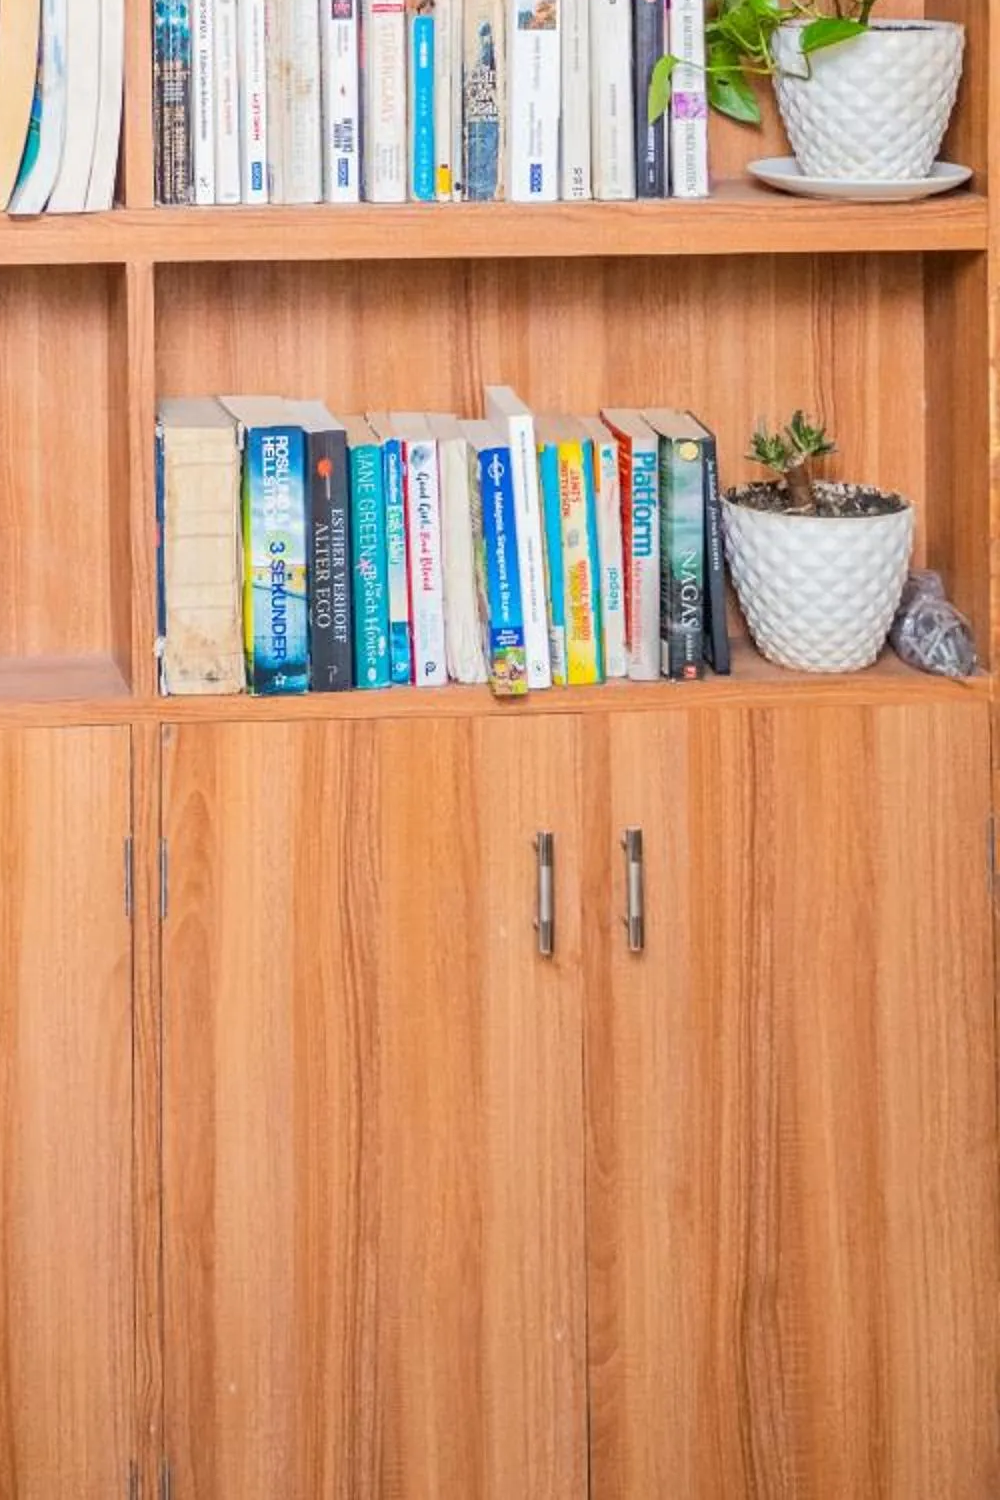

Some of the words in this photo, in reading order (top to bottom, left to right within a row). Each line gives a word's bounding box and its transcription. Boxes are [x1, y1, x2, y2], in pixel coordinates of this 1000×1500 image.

[356, 450, 376, 493] JANE
[415, 471, 431, 500] Good
[357, 498, 378, 558] GREEN
[633, 451, 657, 559] Platform
[269, 540, 286, 554] 3
[314, 522, 331, 583] ALTER
[331, 508, 345, 568] ESTHER
[362, 567, 378, 615] Beach
[420, 557, 434, 592] Blood
[607, 567, 621, 611] Nepal
[680, 550, 699, 628] NAGAS
[270, 559, 287, 661] SEKUNDER
[315, 587, 332, 629] EGO
[332, 572, 348, 643] VERHOEF
